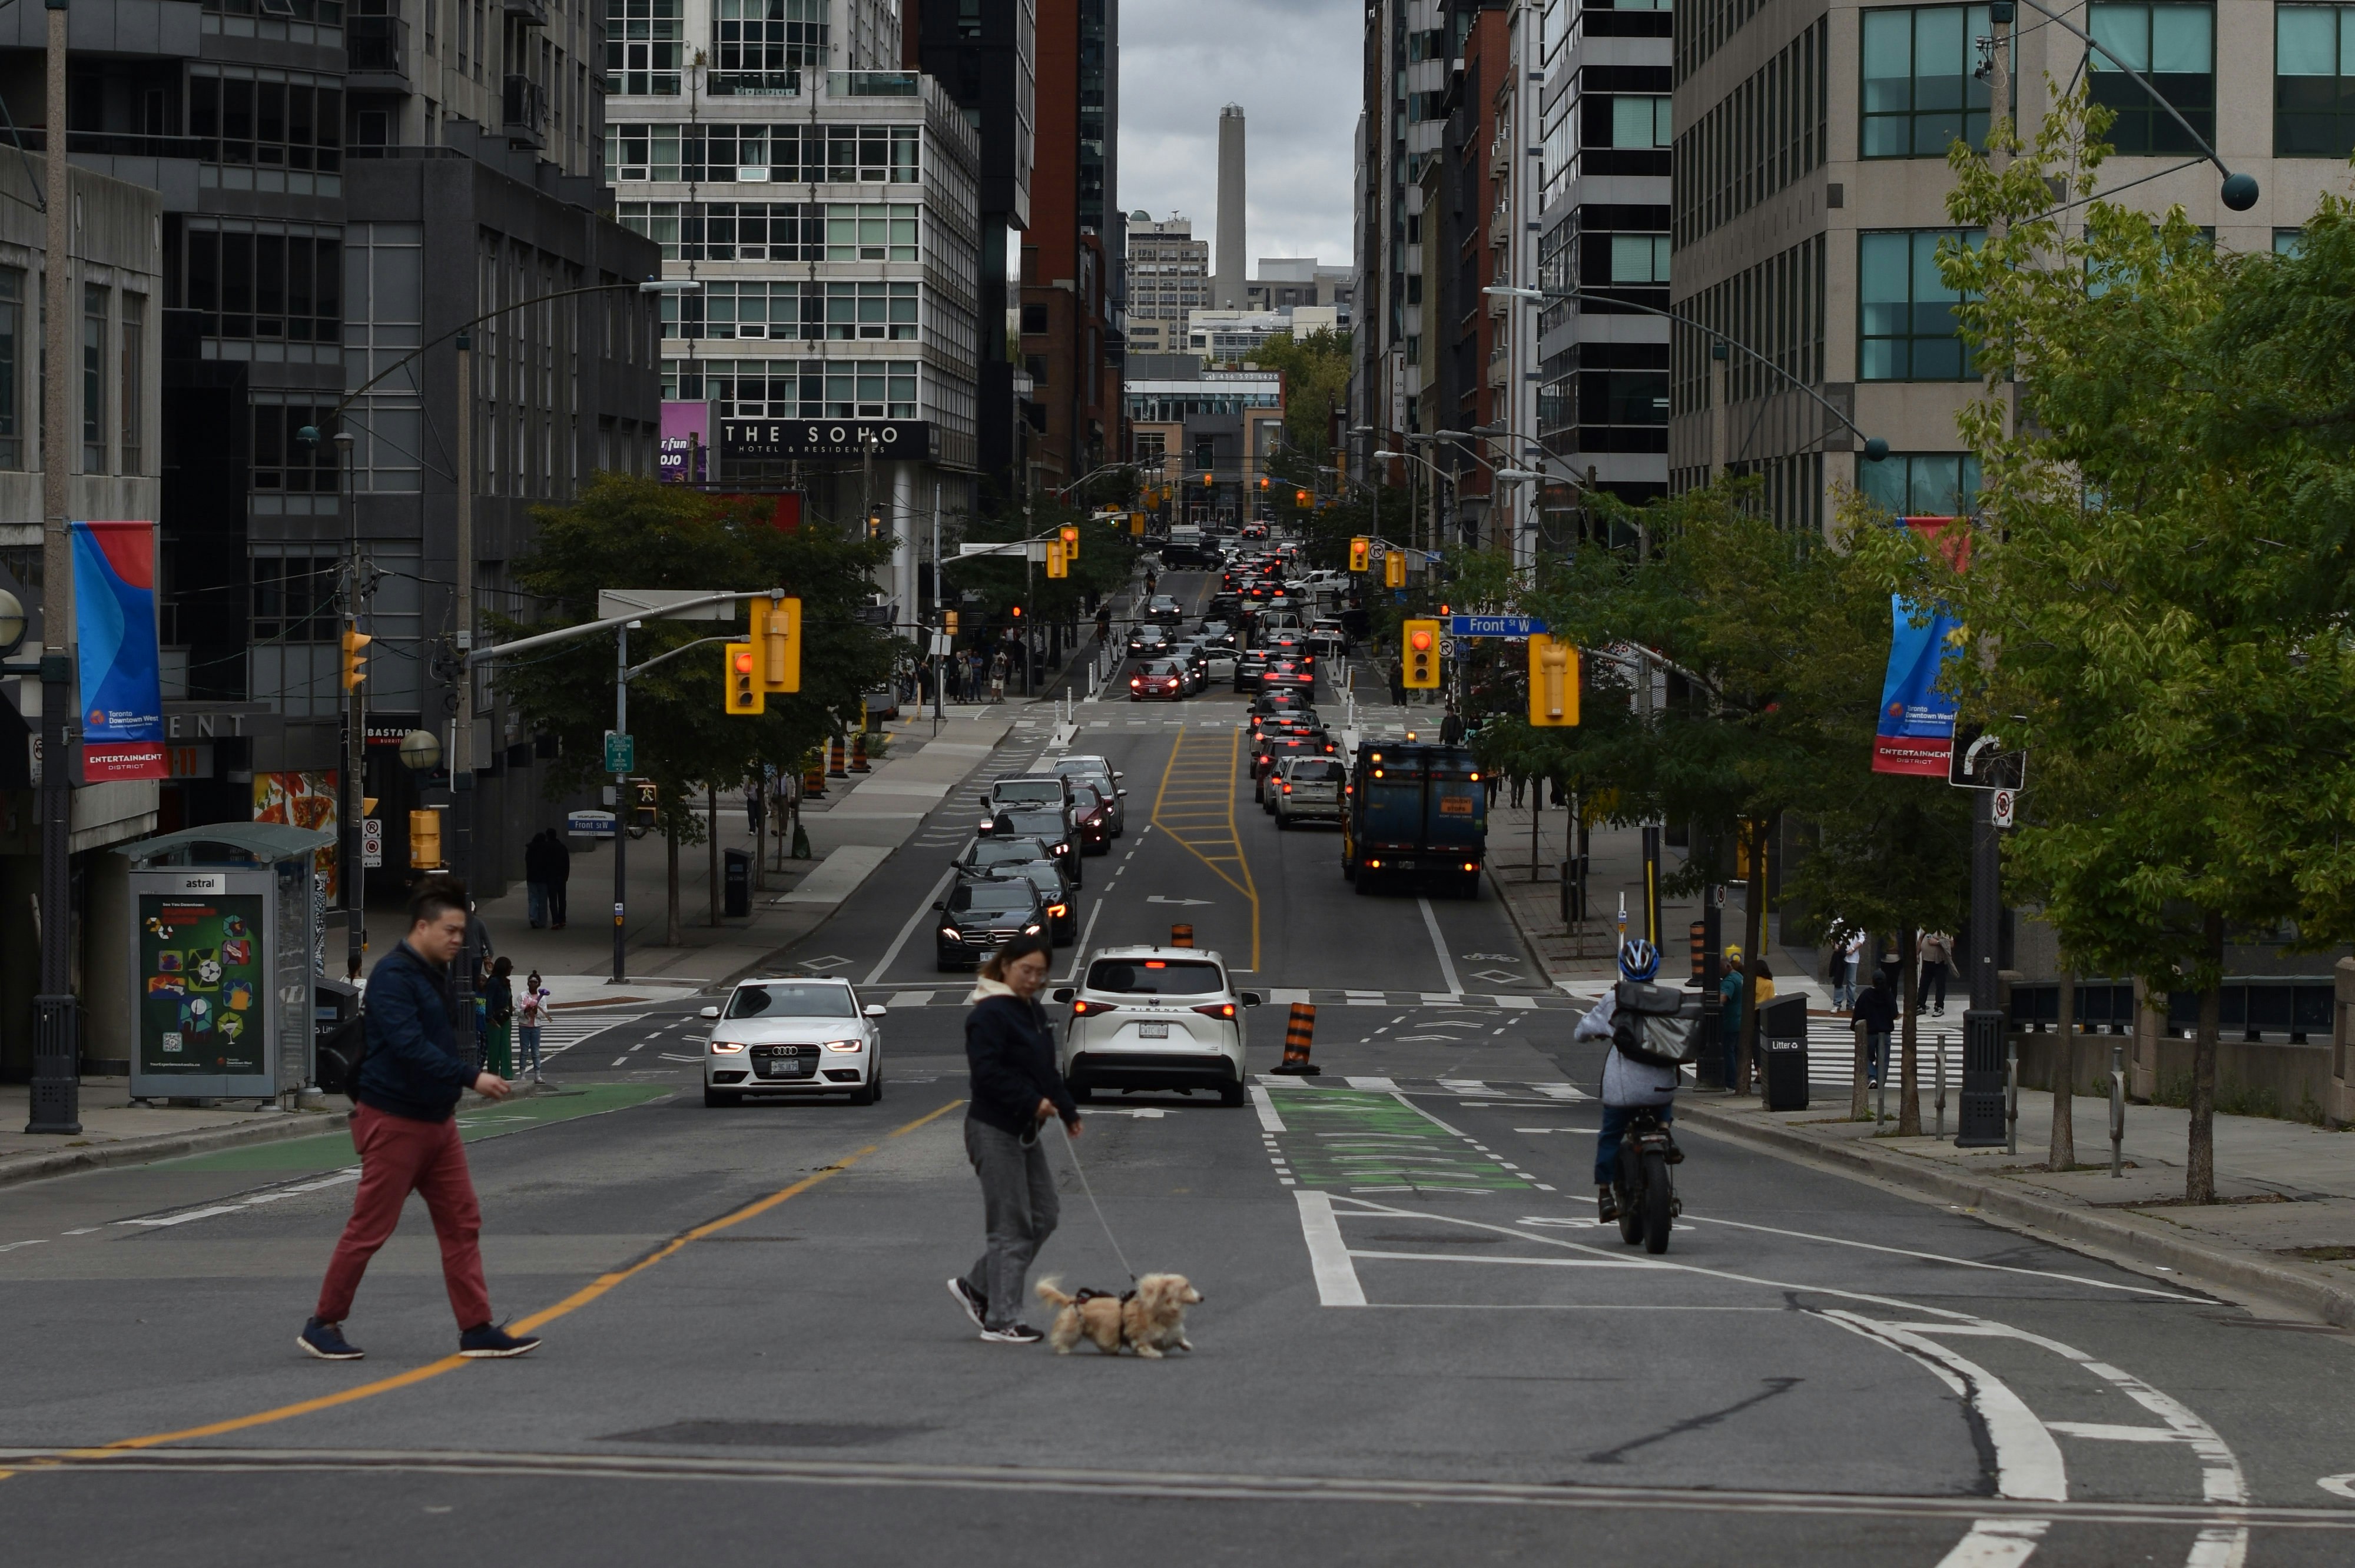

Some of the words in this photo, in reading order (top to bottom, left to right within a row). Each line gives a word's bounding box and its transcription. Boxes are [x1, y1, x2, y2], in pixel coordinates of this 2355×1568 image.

[725, 426, 779, 442] THE
[808, 426, 897, 443] SOHO
[668, 437, 687, 451] fun
[1470, 618, 1505, 632] Front
[1518, 619, 1530, 632] W
[367, 728, 418, 737] BASTAR
[1879, 748, 1952, 758] ENTERTAINMENT
[89, 754, 162, 763] ENTERTAINMENT
[186, 879, 214, 888] astral
[1772, 1041, 1791, 1049] Litter
